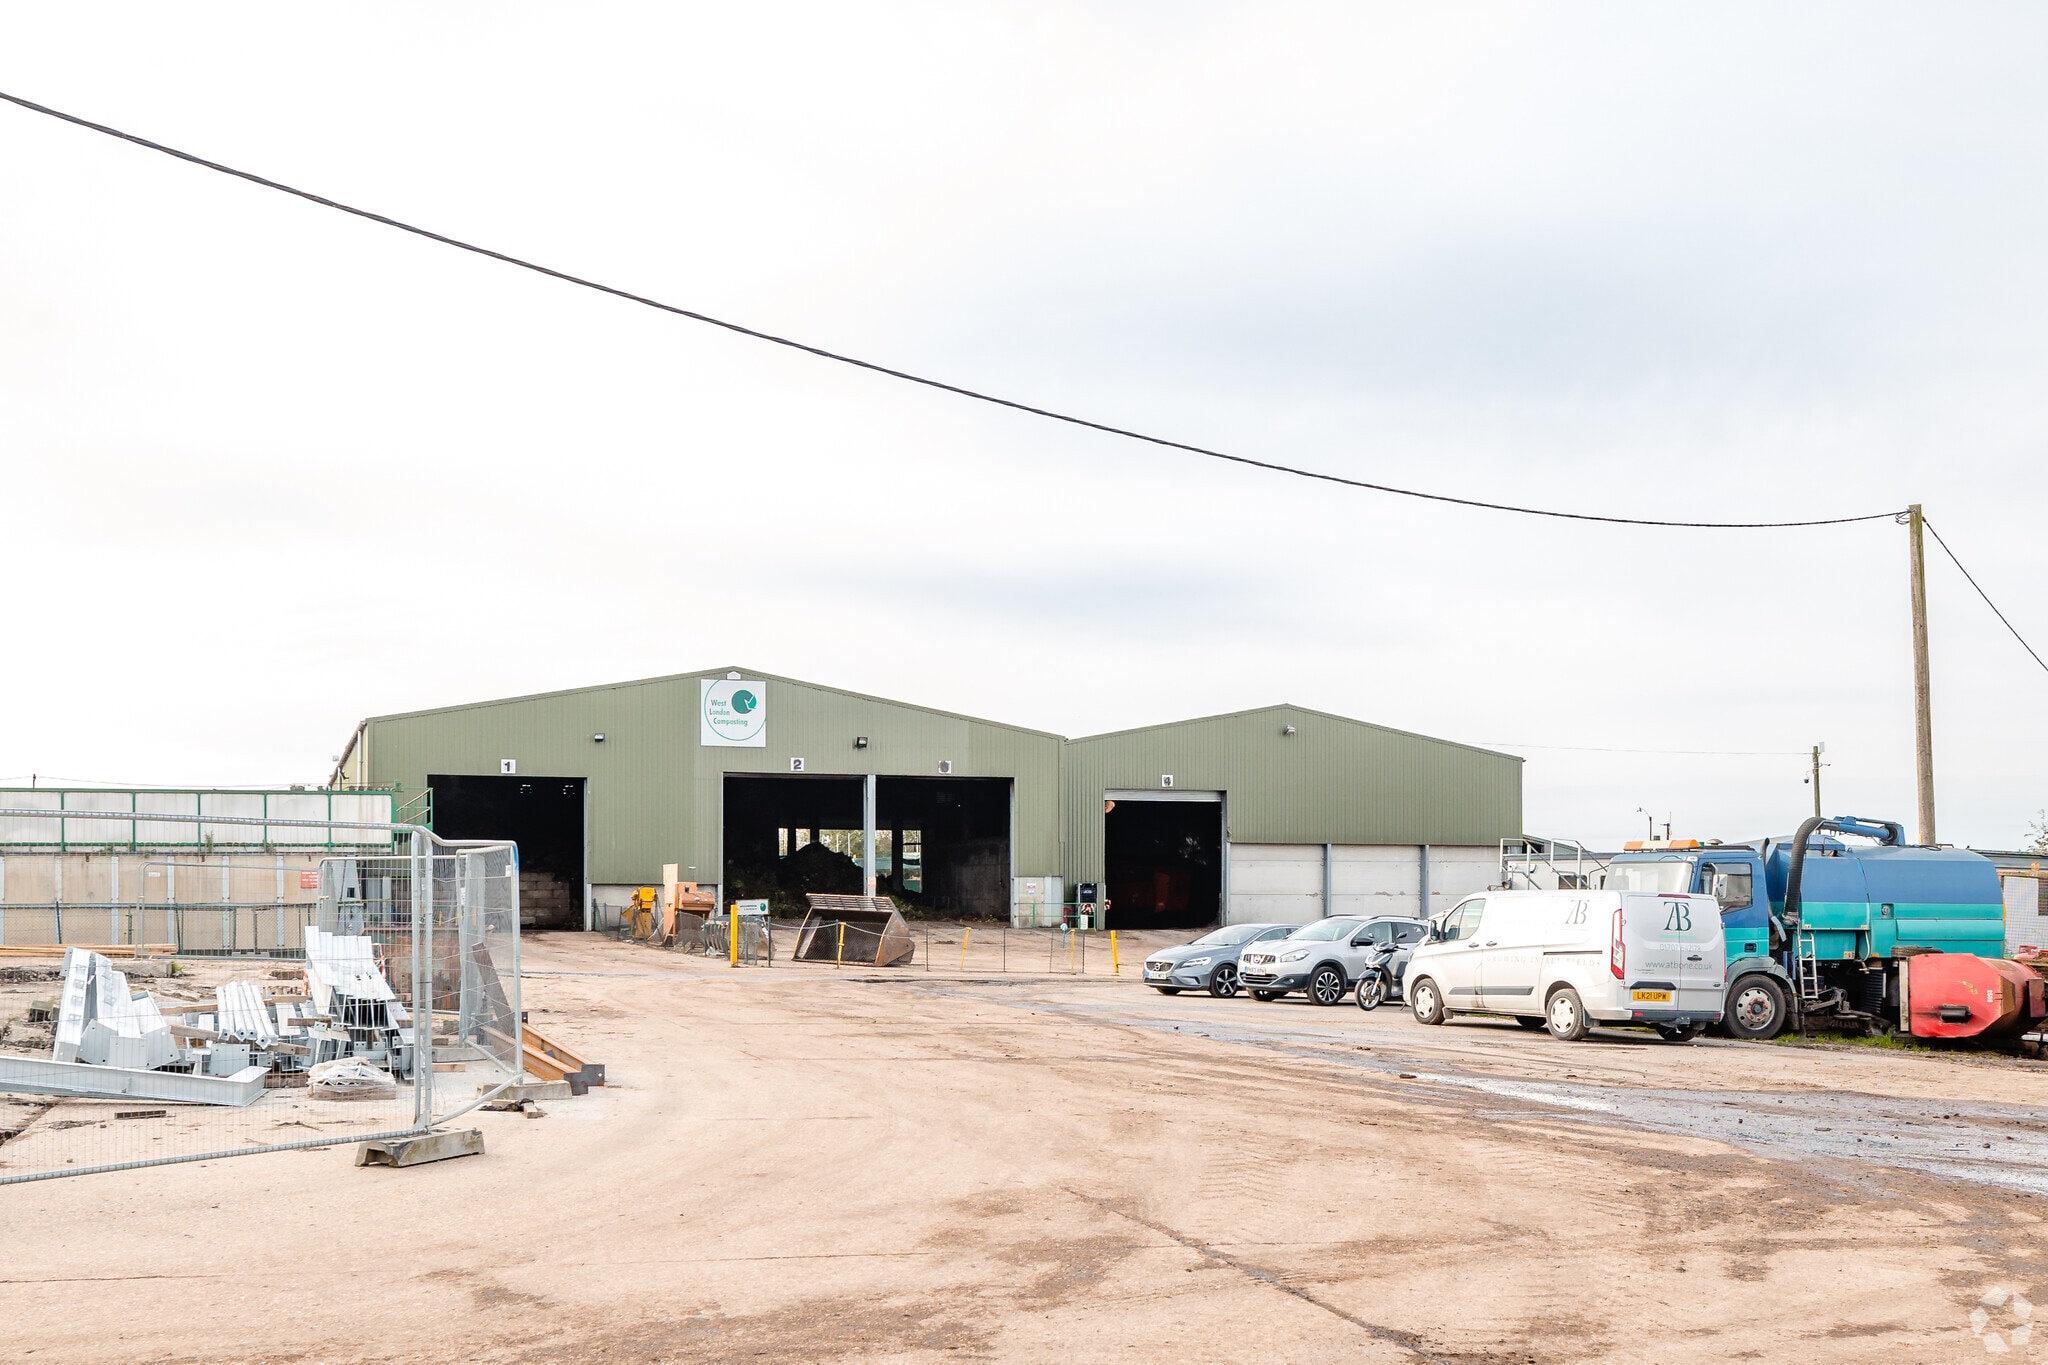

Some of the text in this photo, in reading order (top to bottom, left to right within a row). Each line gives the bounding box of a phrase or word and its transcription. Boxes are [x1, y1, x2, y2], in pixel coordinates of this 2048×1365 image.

[713, 717, 748, 727] Composting
[793, 759, 802, 770] 2
[1163, 776, 1171, 786] 4
[1645, 960, 1712, 970] www.atbone.co.uk
[1637, 991, 1667, 1000] LK21 UPW
